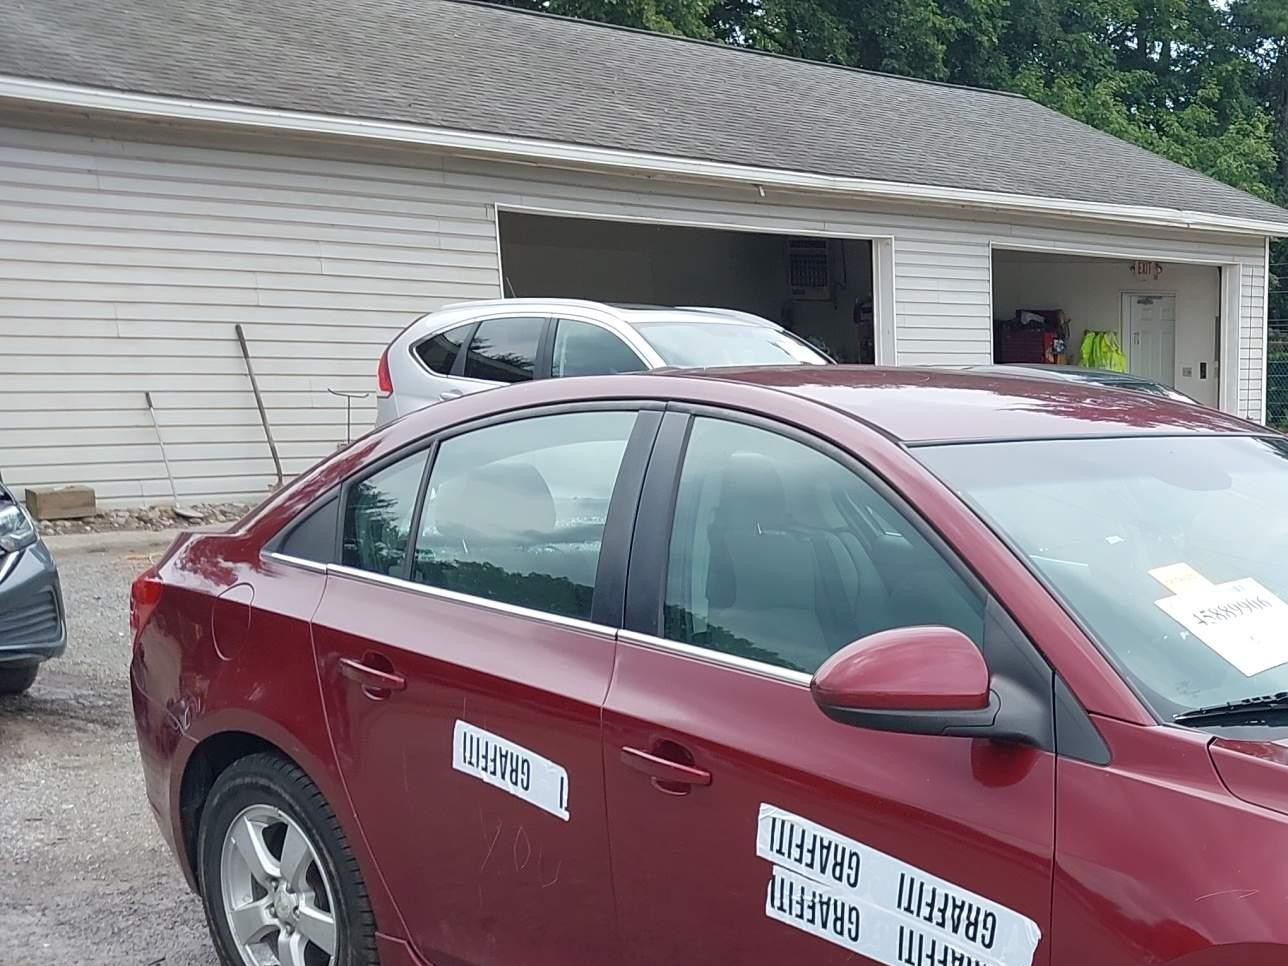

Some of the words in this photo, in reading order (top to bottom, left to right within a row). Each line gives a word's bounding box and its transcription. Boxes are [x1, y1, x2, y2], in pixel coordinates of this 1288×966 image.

[462, 730, 531, 792] GRAFFITI
[769, 816, 861, 889] GRAFFITI
[770, 873, 861, 943] GRAFFITI
[896, 872, 997, 950] GRAFFITI
